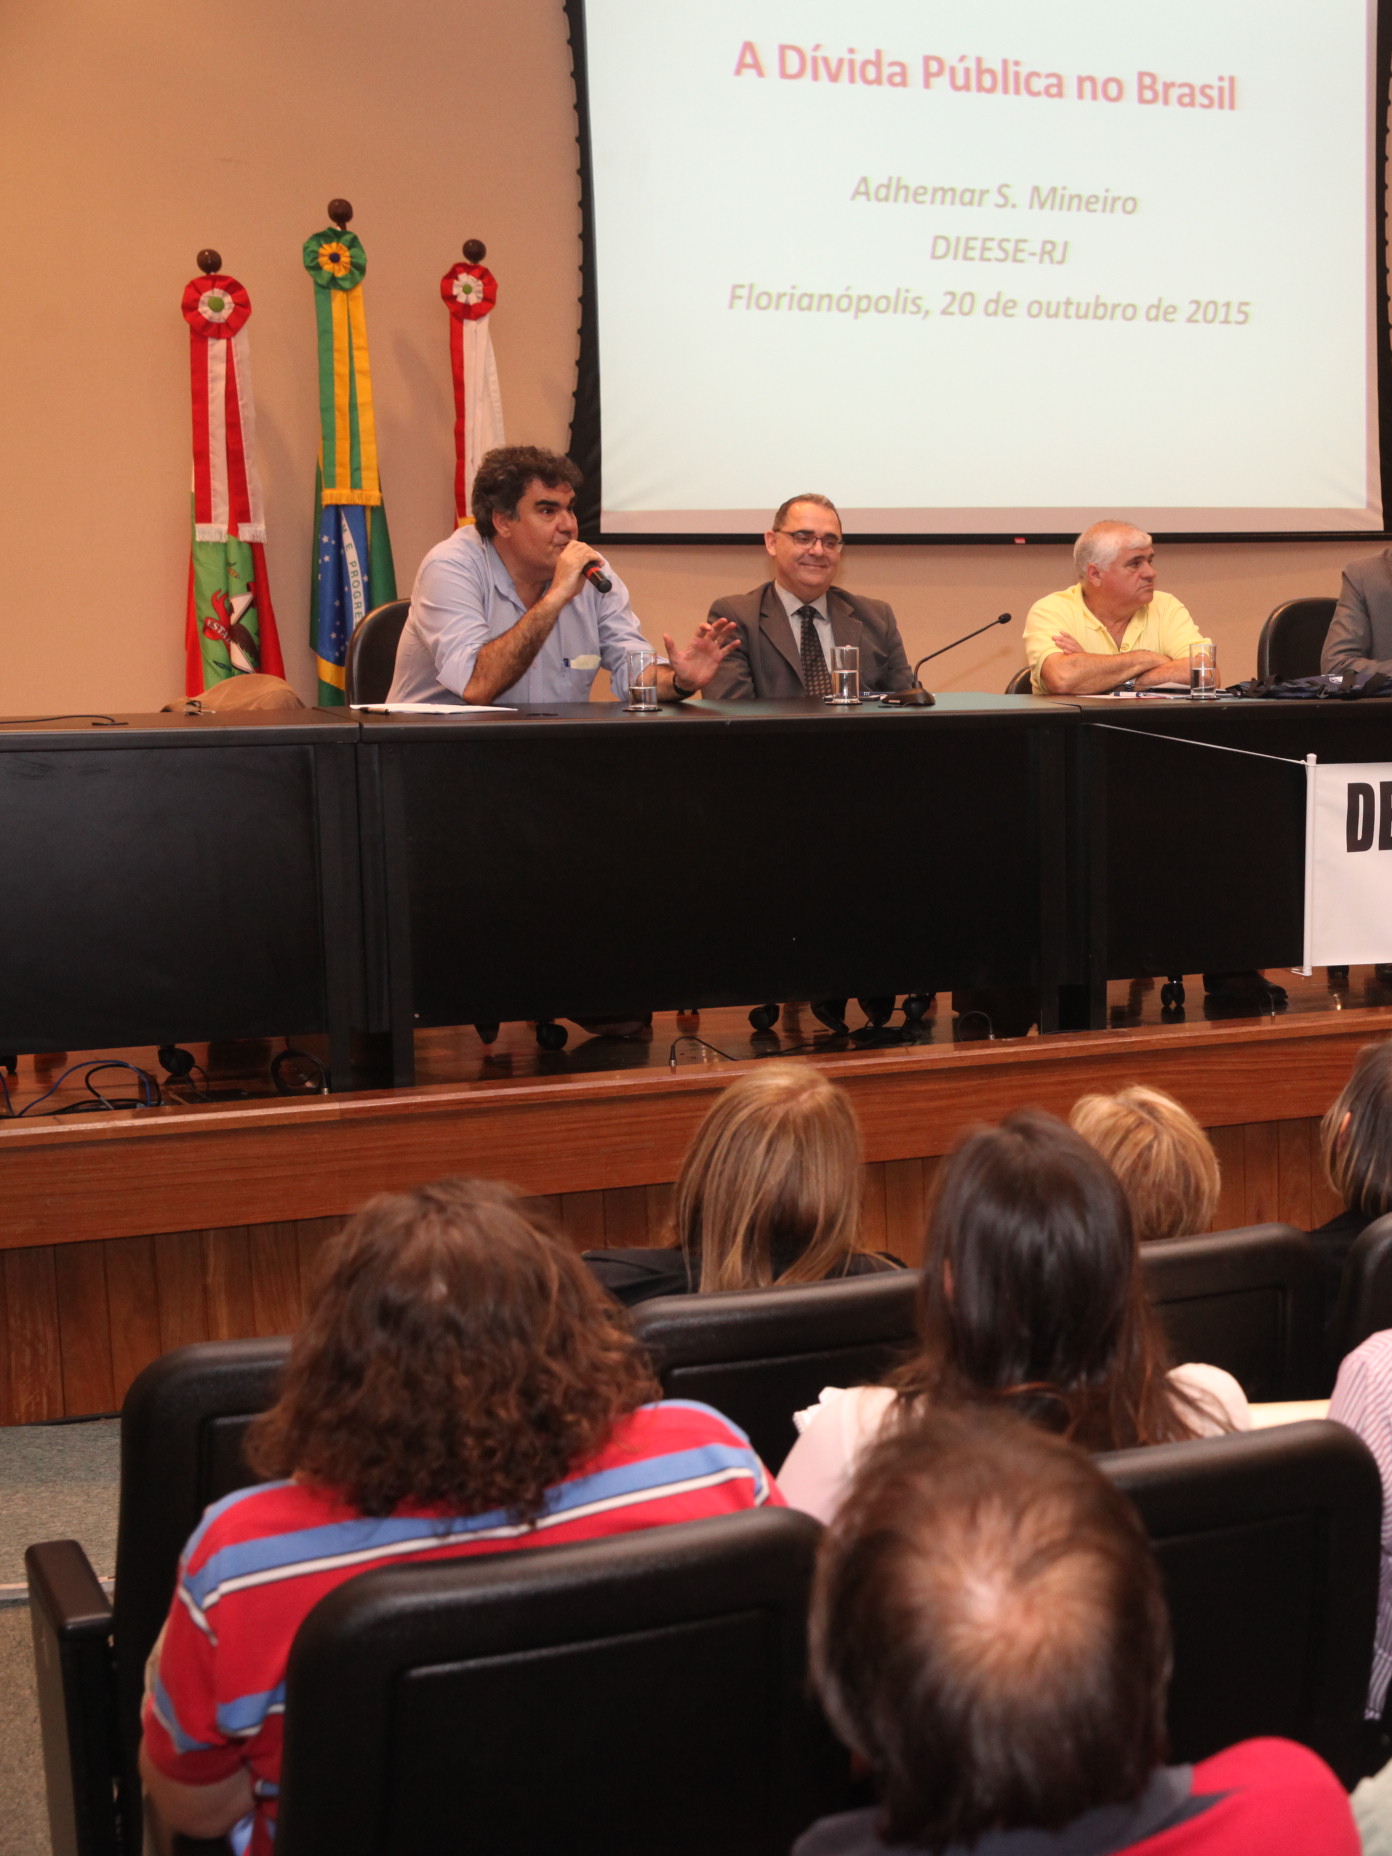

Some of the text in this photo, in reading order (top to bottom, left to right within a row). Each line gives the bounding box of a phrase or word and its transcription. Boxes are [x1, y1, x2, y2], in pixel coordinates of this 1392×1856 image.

[734, 41, 1237, 111] A Dívida Pública no Brasil
[850, 176, 1139, 215] Adhemar S. Mineiro
[930, 235, 1070, 265] DIEESE-RJ
[728, 283, 1251, 326] Florianópolis, 20 de outubro de 2015
